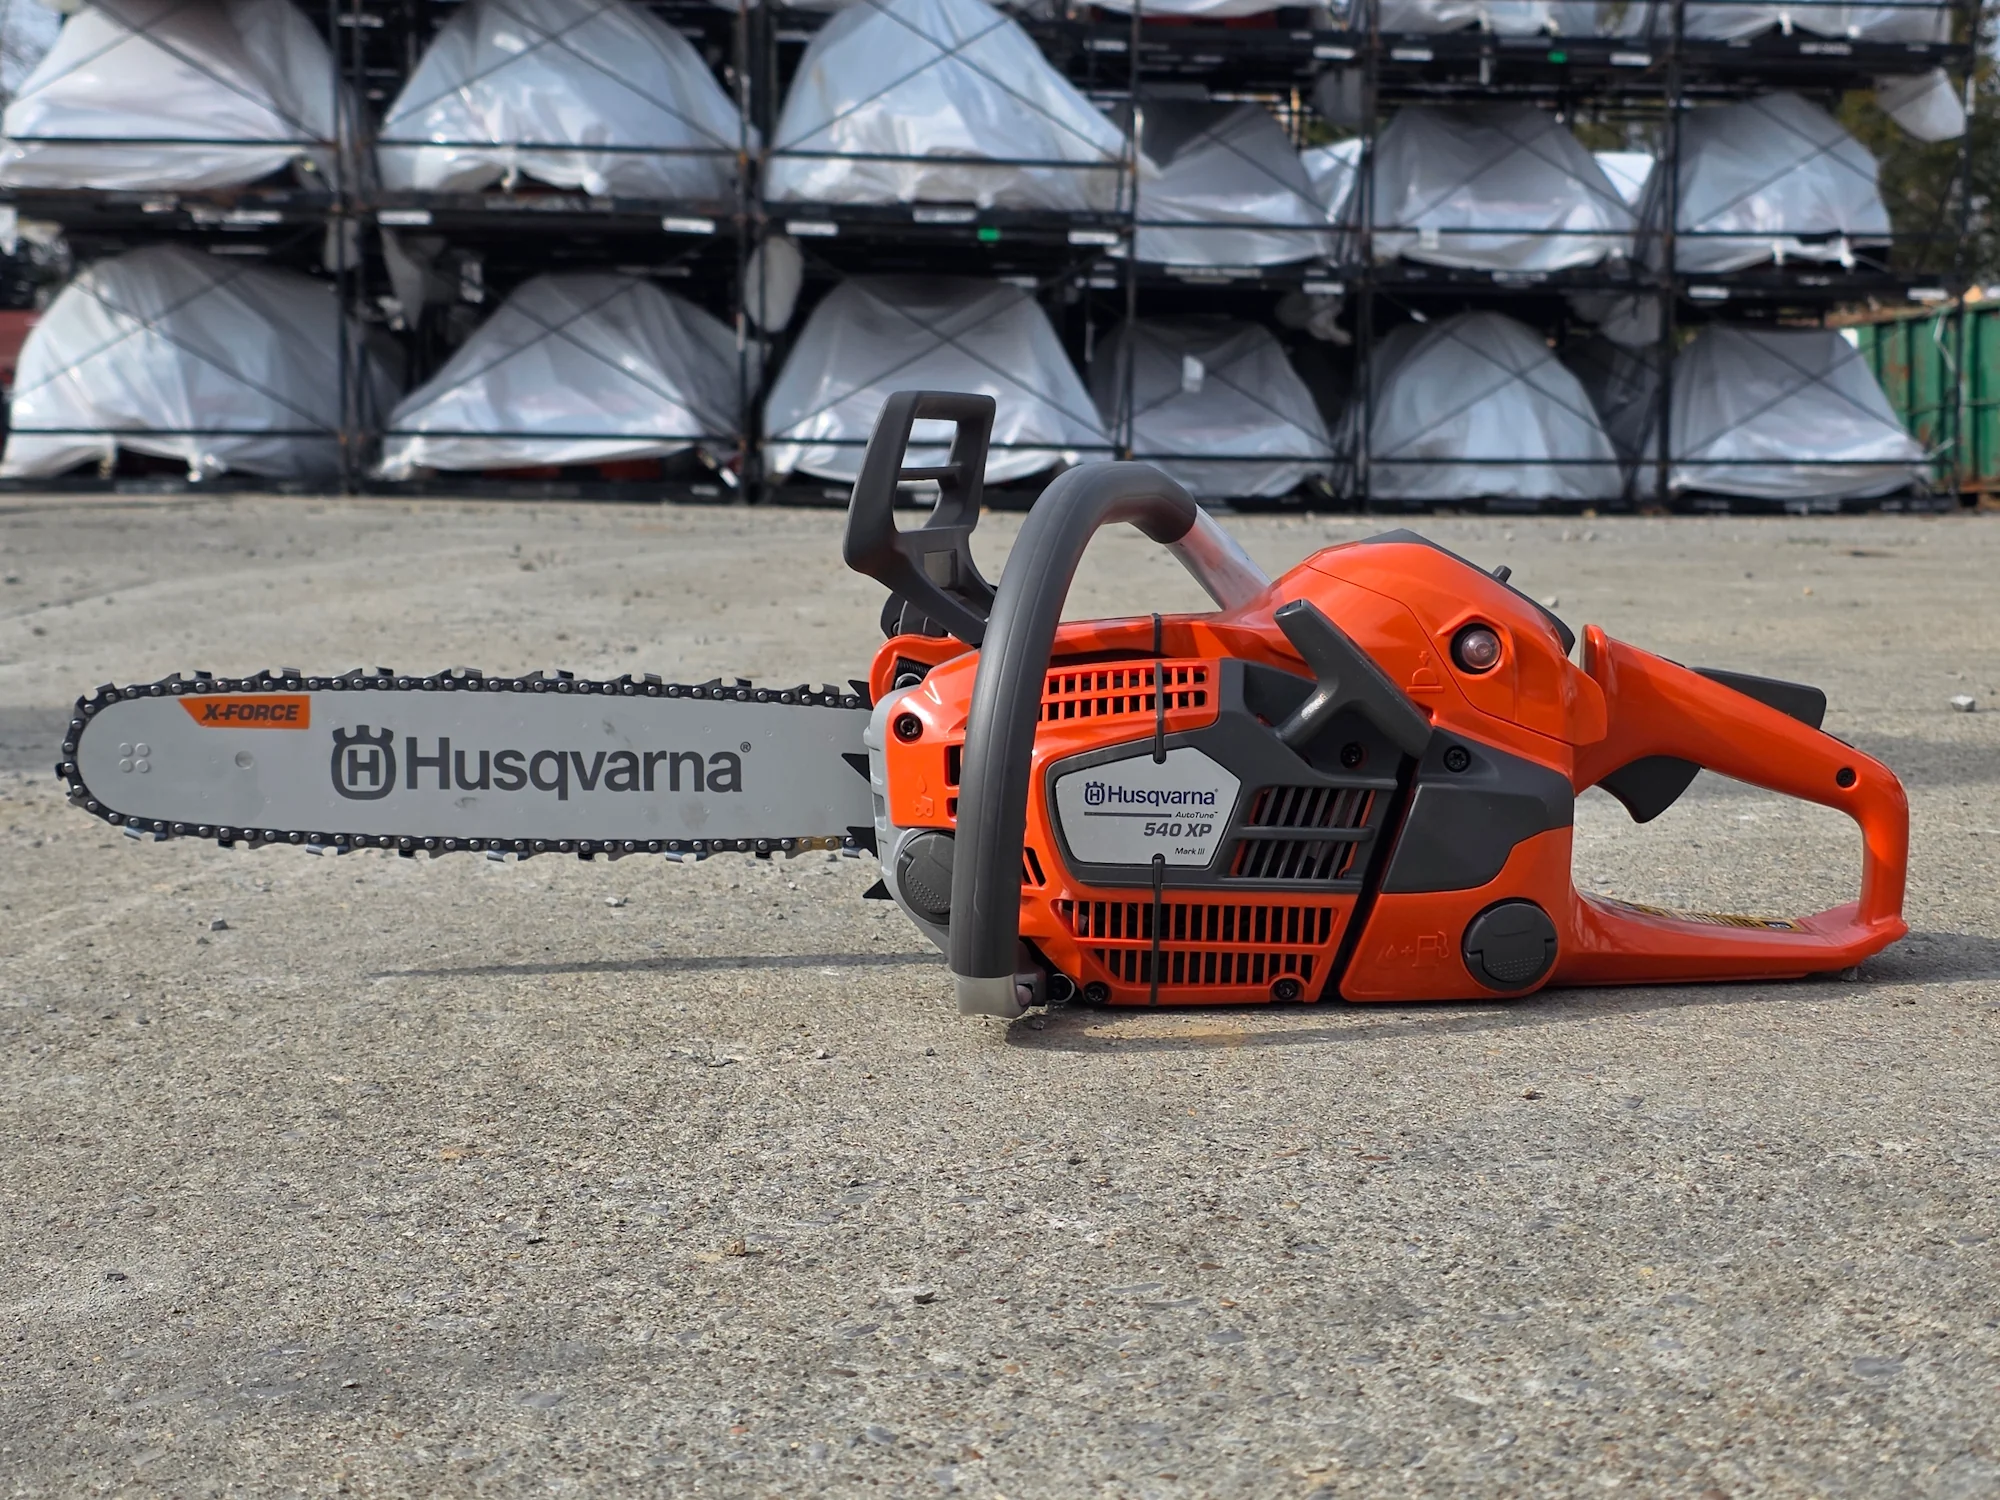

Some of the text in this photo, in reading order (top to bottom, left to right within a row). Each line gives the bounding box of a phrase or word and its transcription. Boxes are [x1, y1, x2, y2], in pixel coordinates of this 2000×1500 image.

[201, 703, 300, 722] X-FORCE
[1143, 822, 1213, 838] 540 XP
[1174, 847, 1197, 856] Mark
